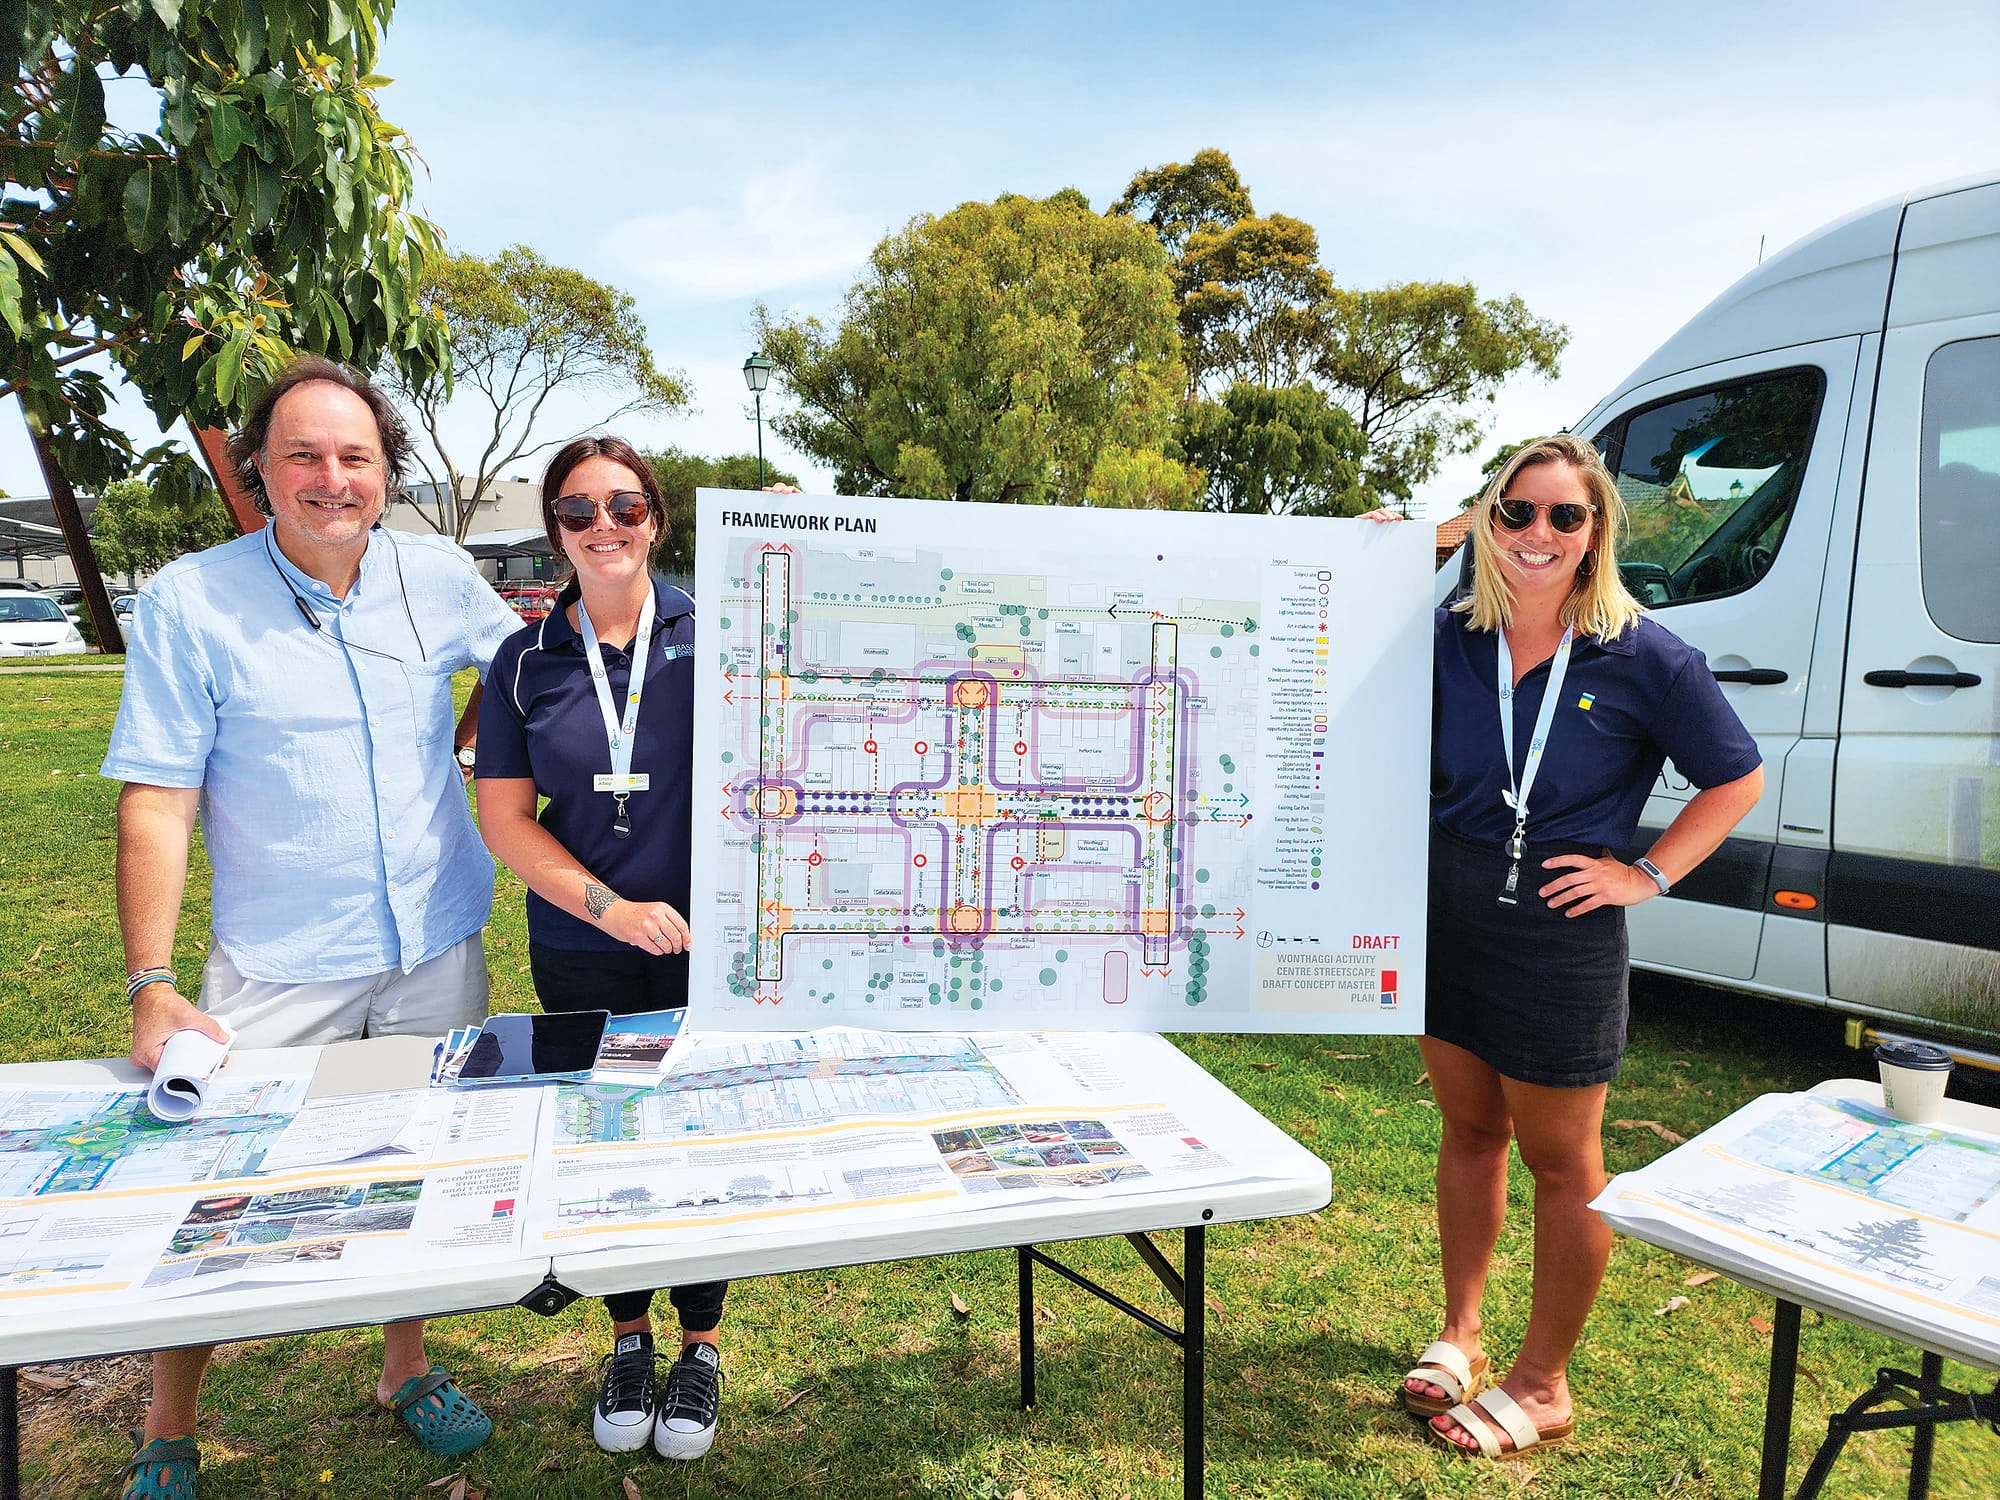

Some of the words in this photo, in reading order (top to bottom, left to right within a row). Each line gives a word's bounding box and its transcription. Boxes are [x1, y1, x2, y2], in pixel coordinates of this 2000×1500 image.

[721, 511, 830, 531] FRAMEWORK
[834, 516, 877, 533] PLAN
[1352, 935, 1400, 950] DRAFT
[1277, 954, 1334, 964] WONTHAGGI
[1336, 955, 1376, 964] ACTIVITY
[1277, 967, 1311, 976] CENTRE
[1313, 967, 1376, 977] STREETSCAPE
[1262, 979, 1292, 989] DRAFT
[1294, 980, 1336, 989] CONCEPT
[1338, 980, 1376, 990] MASTER
[1351, 993, 1375, 1002] PLAN
[485, 1170, 521, 1178] CENTRE
[456, 1175, 521, 1187] STREETSCAPE
[442, 1186, 475, 1194] DRAFT
[476, 1180, 520, 1190] CONCEPT
[450, 1190, 491, 1198] MASTER
[494, 1186, 520, 1194] PLAN
[549, 1228, 588, 1239] Section
